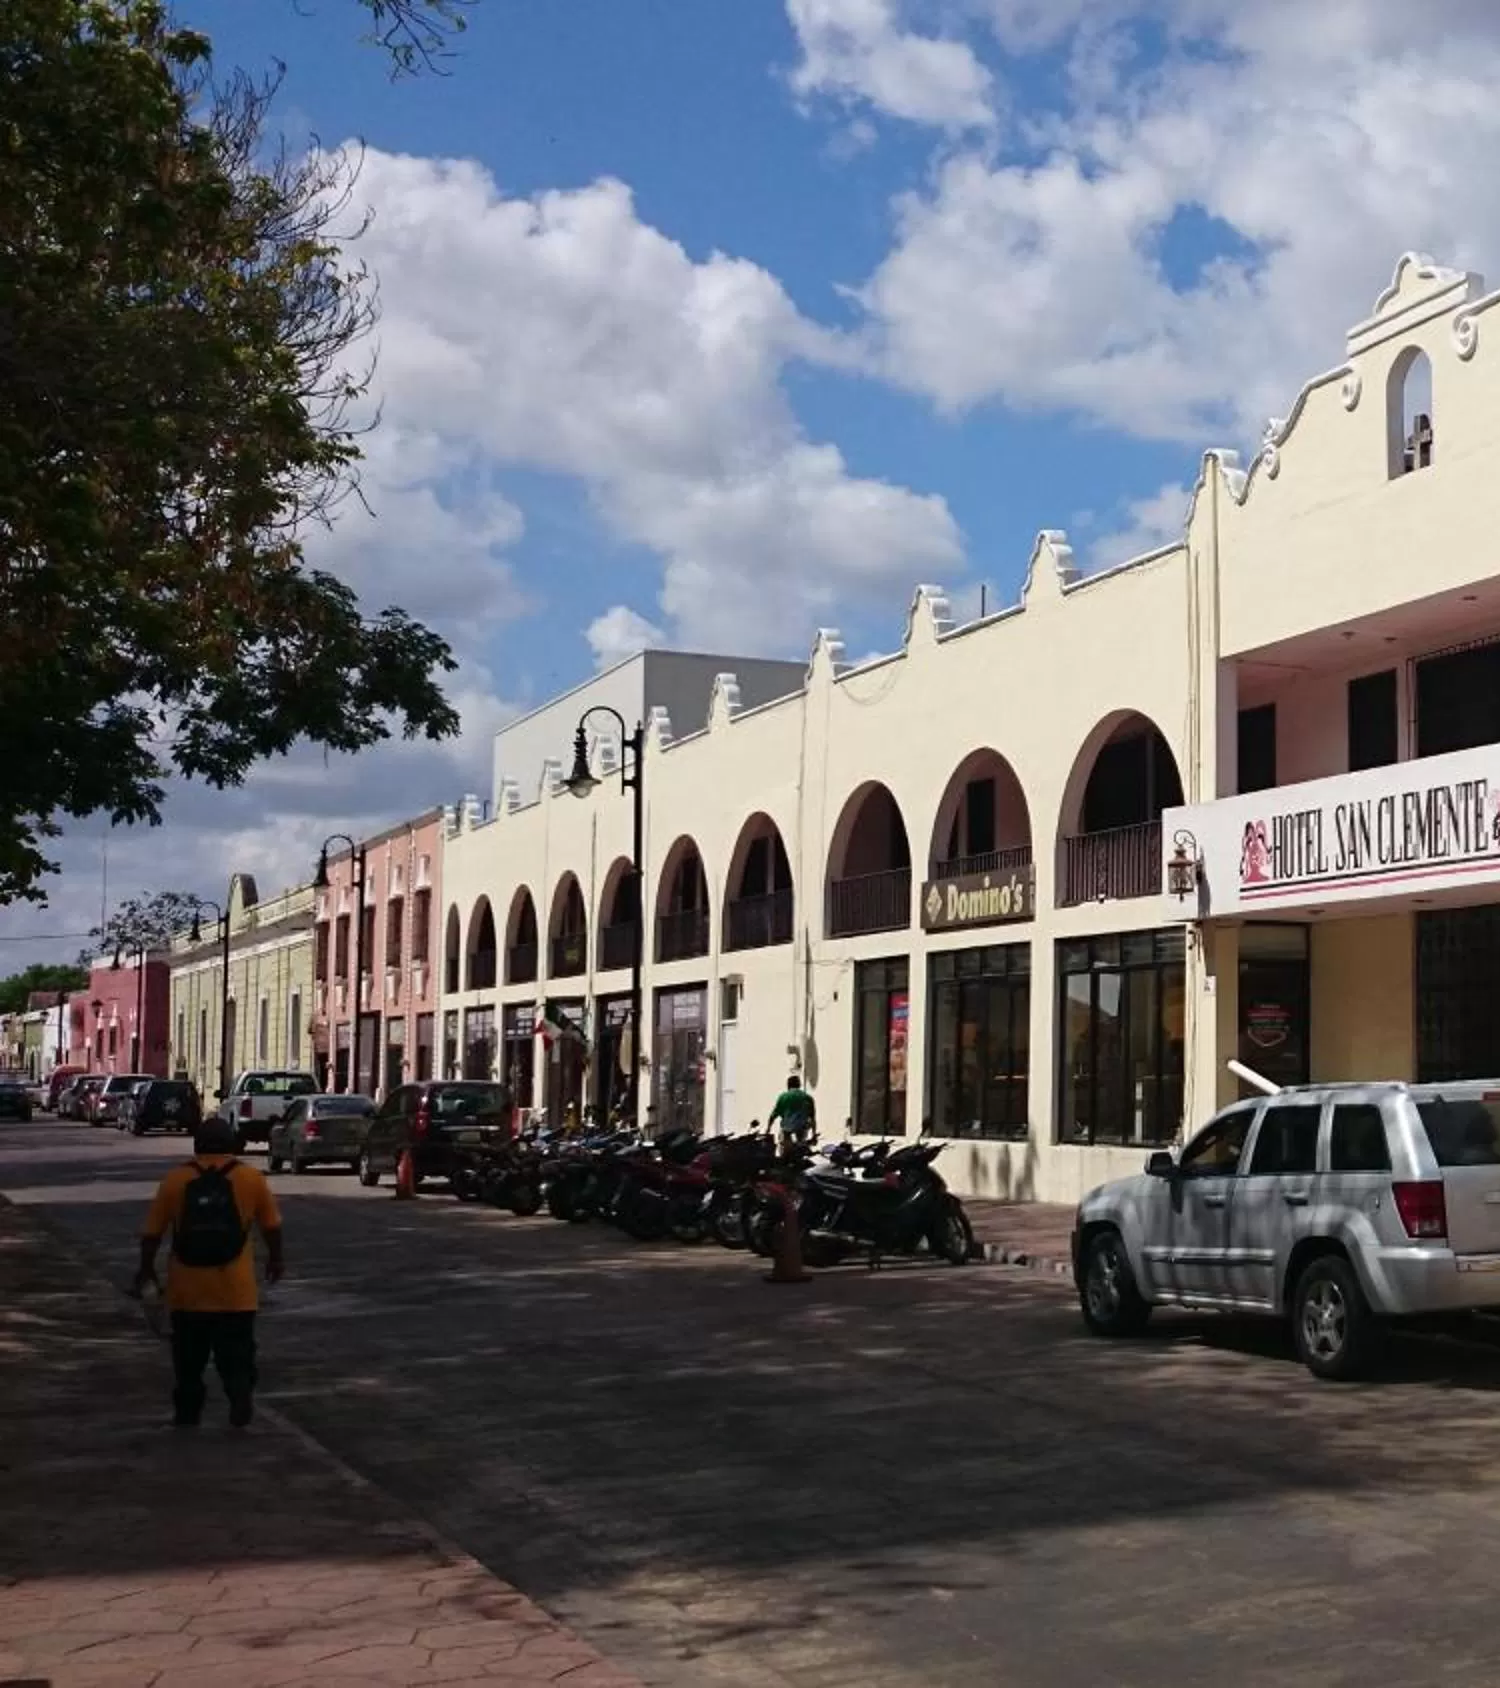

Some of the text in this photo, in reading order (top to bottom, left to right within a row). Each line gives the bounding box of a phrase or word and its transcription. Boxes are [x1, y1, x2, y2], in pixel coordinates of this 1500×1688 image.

[1272, 778, 1489, 881] HOTEL SAN CLEMENTE
[947, 874, 1024, 921] Domino's
